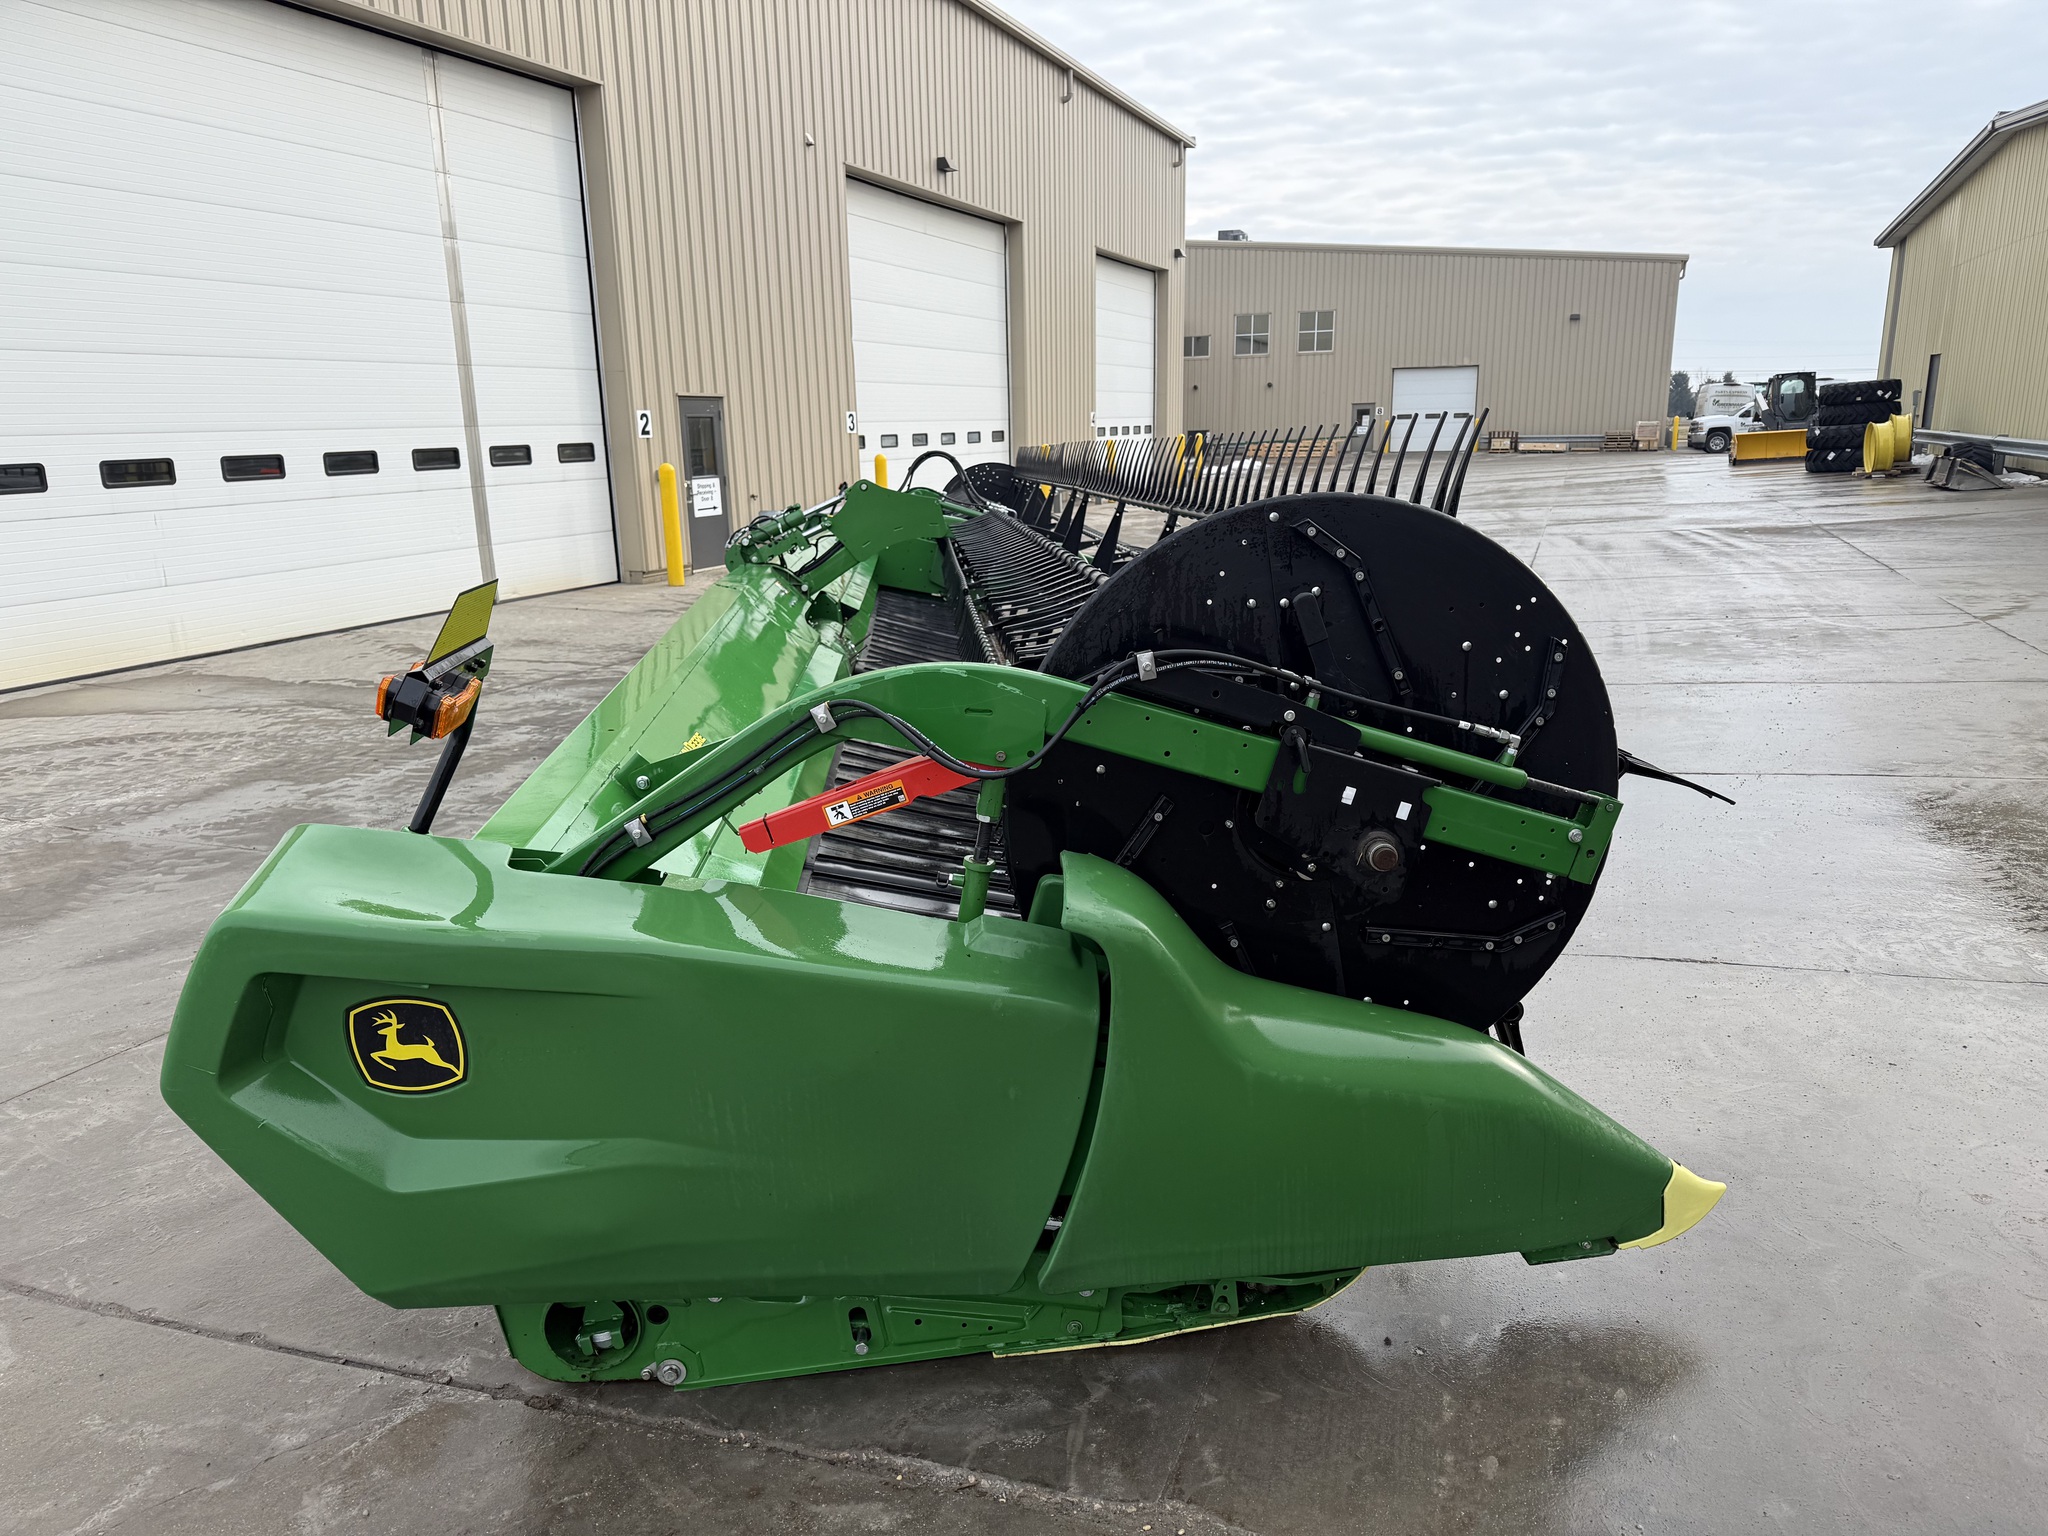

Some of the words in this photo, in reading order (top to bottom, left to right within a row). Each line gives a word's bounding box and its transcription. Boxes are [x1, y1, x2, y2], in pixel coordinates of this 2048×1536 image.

[1377, 407, 1383, 415] 8
[640, 412, 651, 436] 2
[848, 413, 855, 432] 3
[863, 783, 894, 798] WARNING
